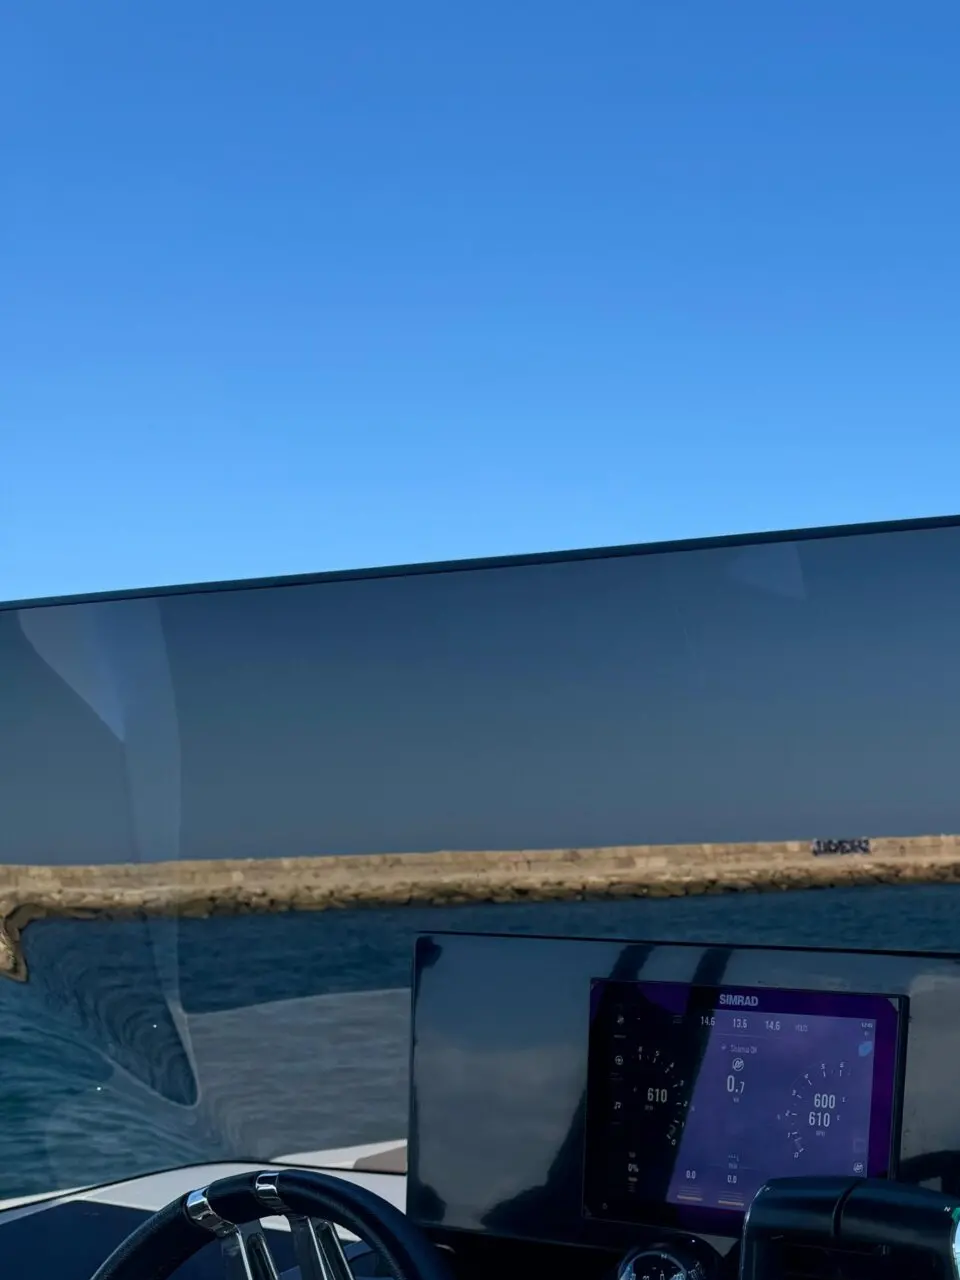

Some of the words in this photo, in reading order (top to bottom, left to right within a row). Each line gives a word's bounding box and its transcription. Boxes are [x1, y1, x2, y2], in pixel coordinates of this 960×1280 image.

[719, 993, 758, 1006] SIMRAD
[727, 1074, 745, 1094] 0.7
[647, 1087, 668, 1103] 610
[814, 1093, 836, 1109] 600
[809, 1111, 831, 1129] 610
